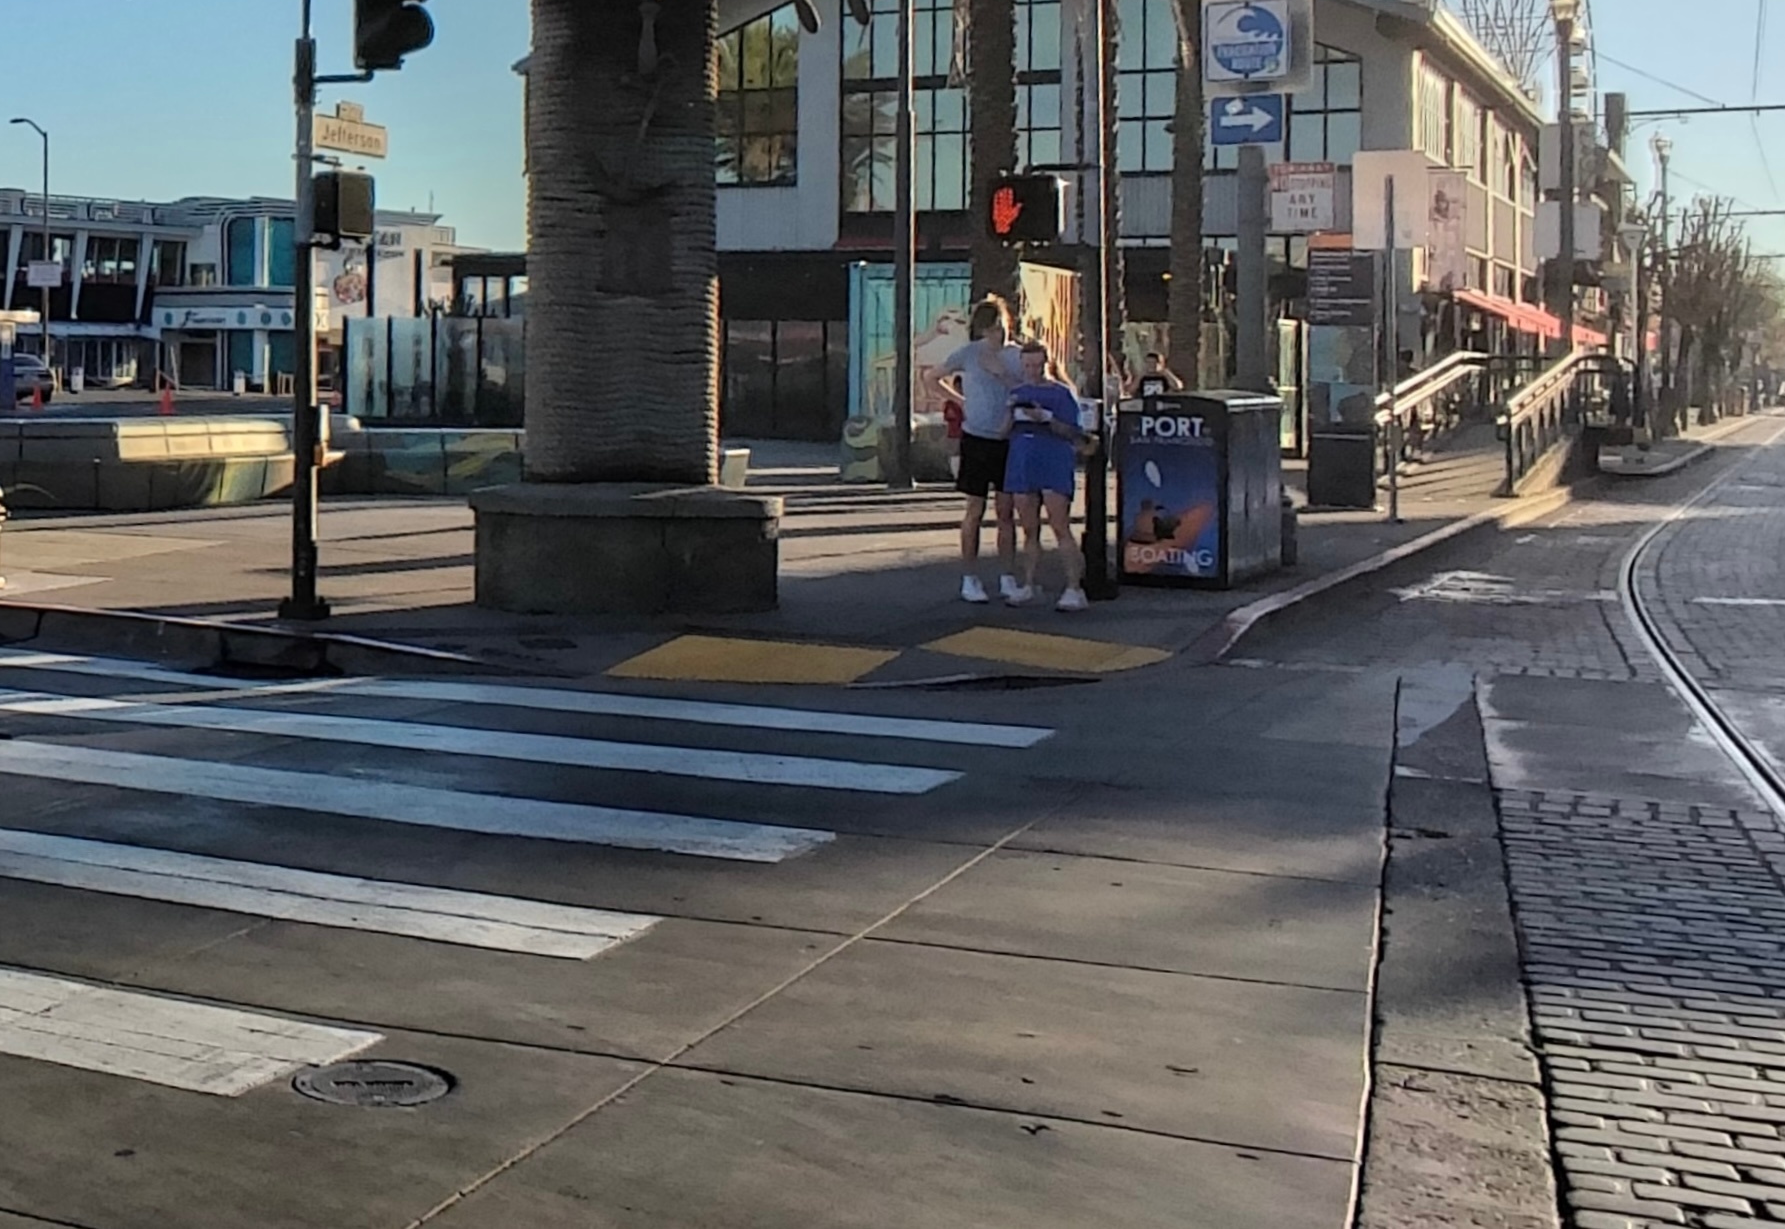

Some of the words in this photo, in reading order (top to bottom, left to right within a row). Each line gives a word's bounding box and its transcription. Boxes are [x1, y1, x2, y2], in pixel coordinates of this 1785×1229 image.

[321, 124, 381, 148] Jefferson
[1287, 207, 1319, 219] TIME
[1141, 416, 1204, 437] PORT
